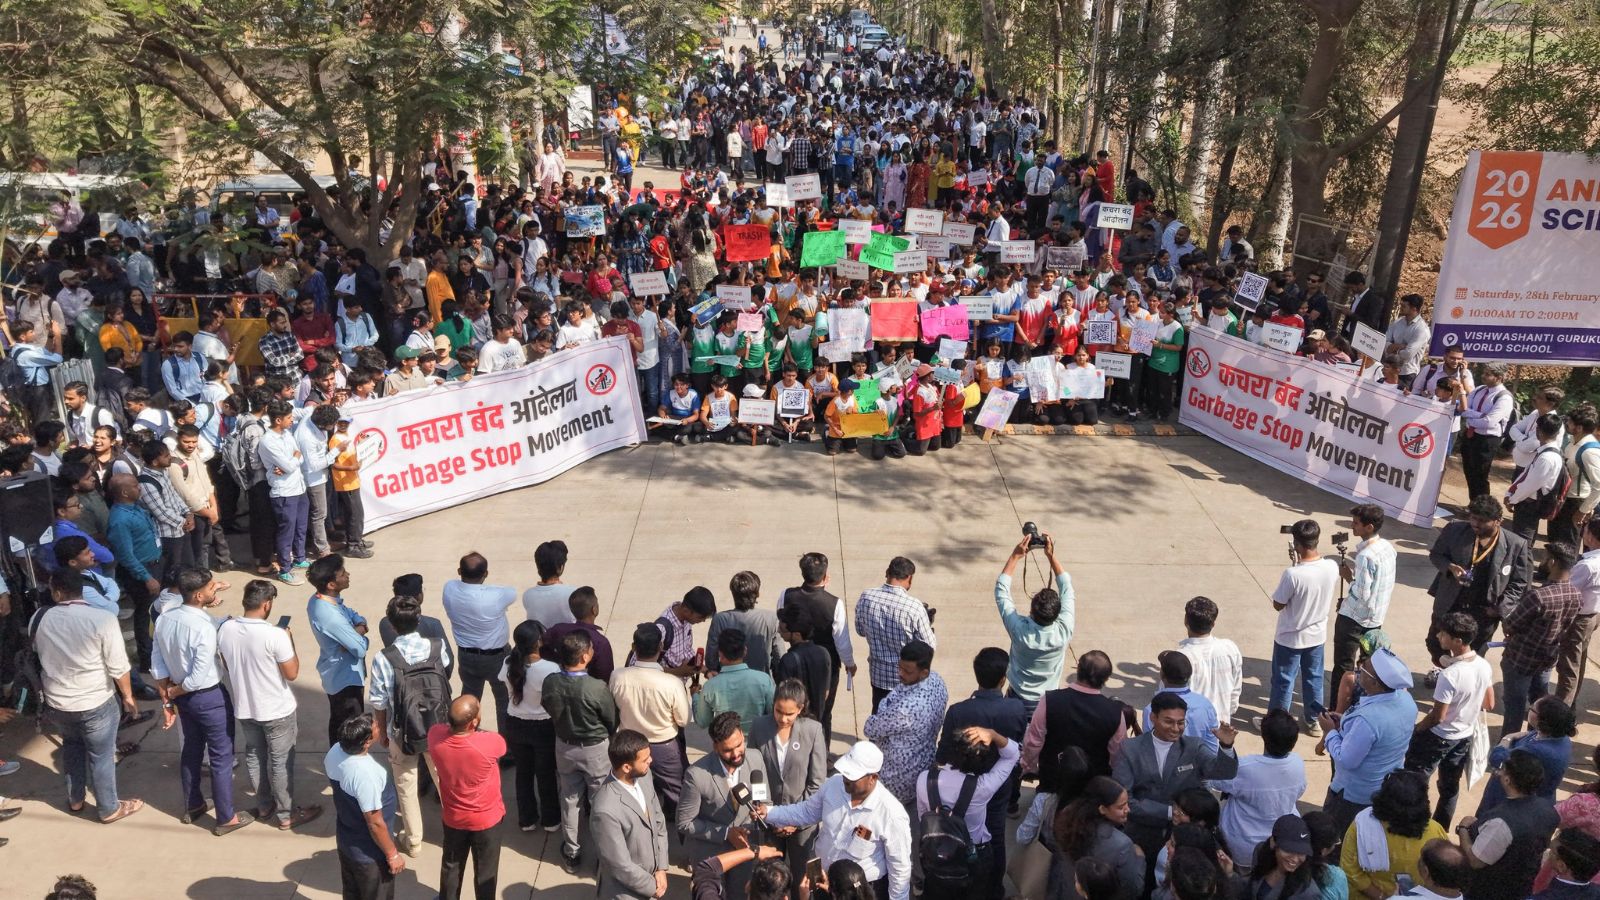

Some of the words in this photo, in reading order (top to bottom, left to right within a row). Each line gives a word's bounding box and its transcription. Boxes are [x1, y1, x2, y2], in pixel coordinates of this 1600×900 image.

[1482, 169, 1530, 197] 20
[1546, 178, 1600, 202] AN
[1476, 202, 1522, 230] 26
[736, 232, 762, 240] TRASH
[1473, 290, 1522, 302] Saturday,
[1526, 290, 1549, 300] 28th
[1553, 291, 1599, 304] February
[1468, 308, 1515, 319] 10:00AM
[1519, 310, 1534, 319] TO
[1538, 310, 1578, 320] 2:00PM
[1462, 342, 1502, 353] WORLD
[1506, 344, 1553, 354] SCHOOL
[1464, 331, 1554, 342] VISHWASHANTI
[397, 411, 464, 450] कचरा
[466, 400, 504, 433] बंद
[511, 379, 578, 425] आंदोलन
[1218, 362, 1276, 400] कचरा
[1274, 376, 1304, 412] बंद
[1305, 391, 1389, 445] आंदोलन
[373, 455, 466, 498] Garbage
[471, 440, 522, 472] Stop
[528, 404, 614, 458] Movement
[1188, 386, 1258, 430] Garbage
[1260, 415, 1304, 450] Stop
[1306, 431, 1415, 492] Movement
